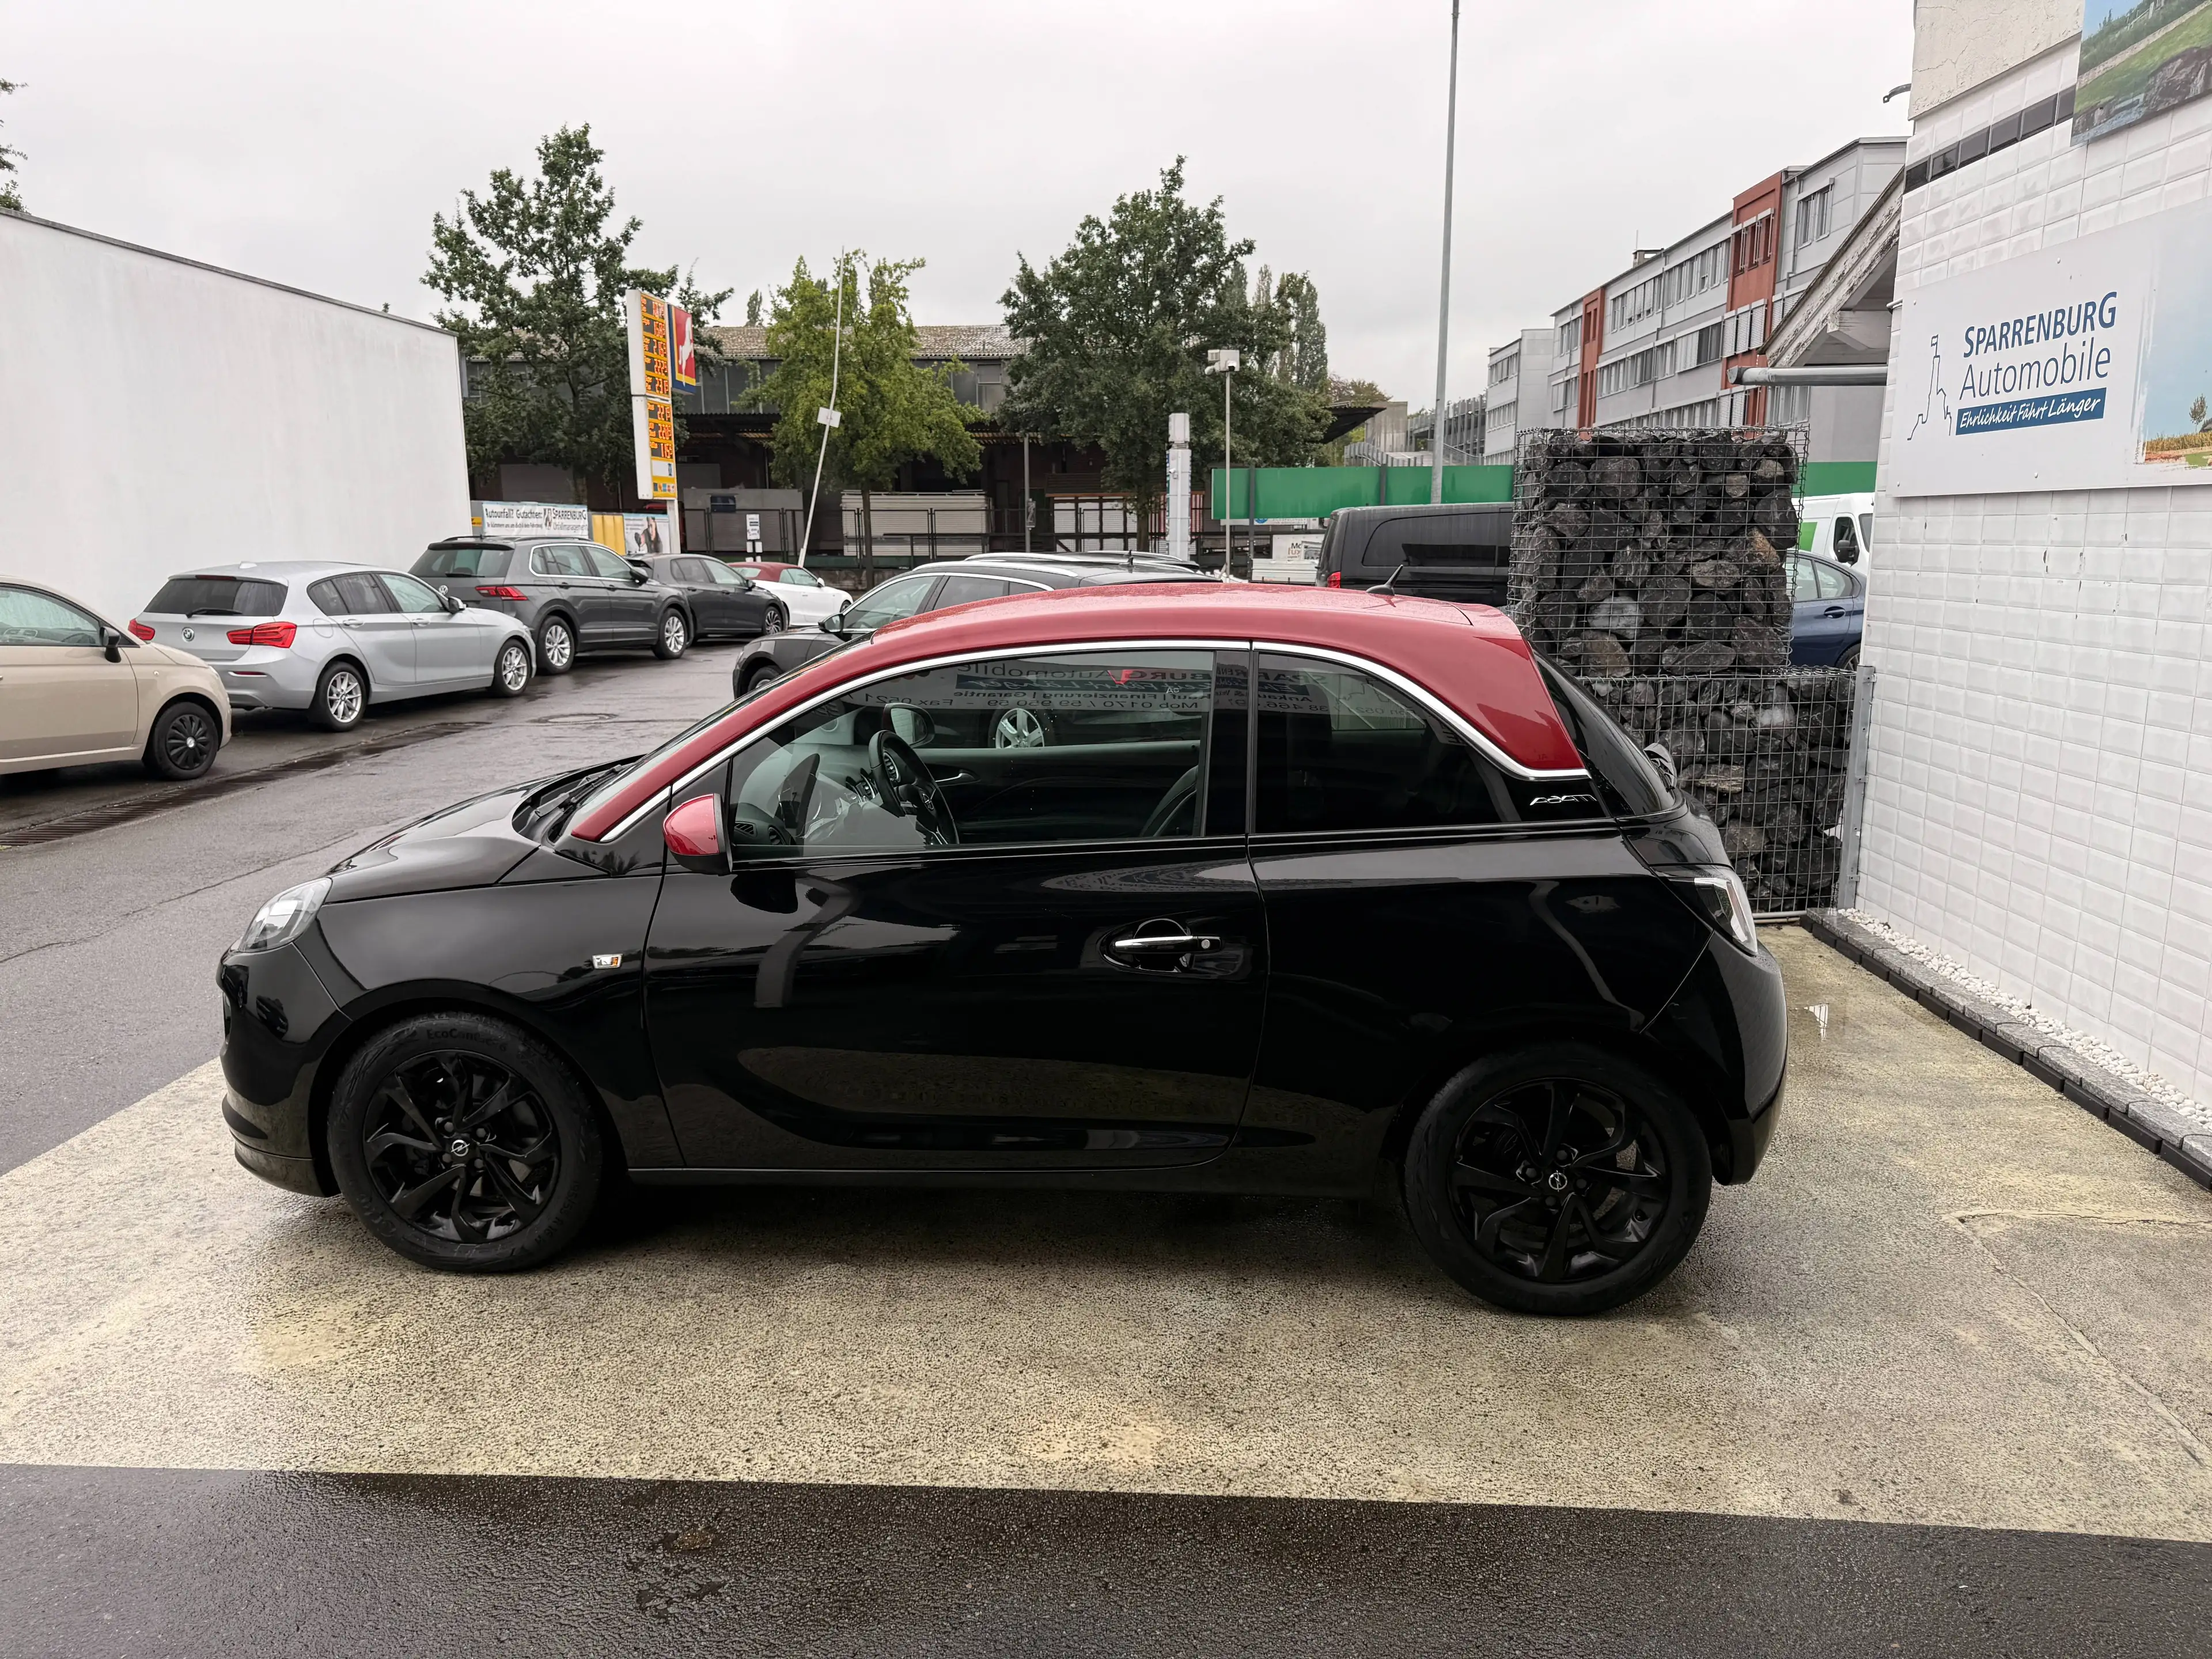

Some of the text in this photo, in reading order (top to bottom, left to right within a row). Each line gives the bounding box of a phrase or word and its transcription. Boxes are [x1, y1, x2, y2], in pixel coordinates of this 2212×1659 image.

[1963, 291, 2118, 358] SPARRENBURG
[1959, 336, 2111, 400] Automobile
[1960, 397, 2101, 428] Ehrlichkeit Fährt Länger
